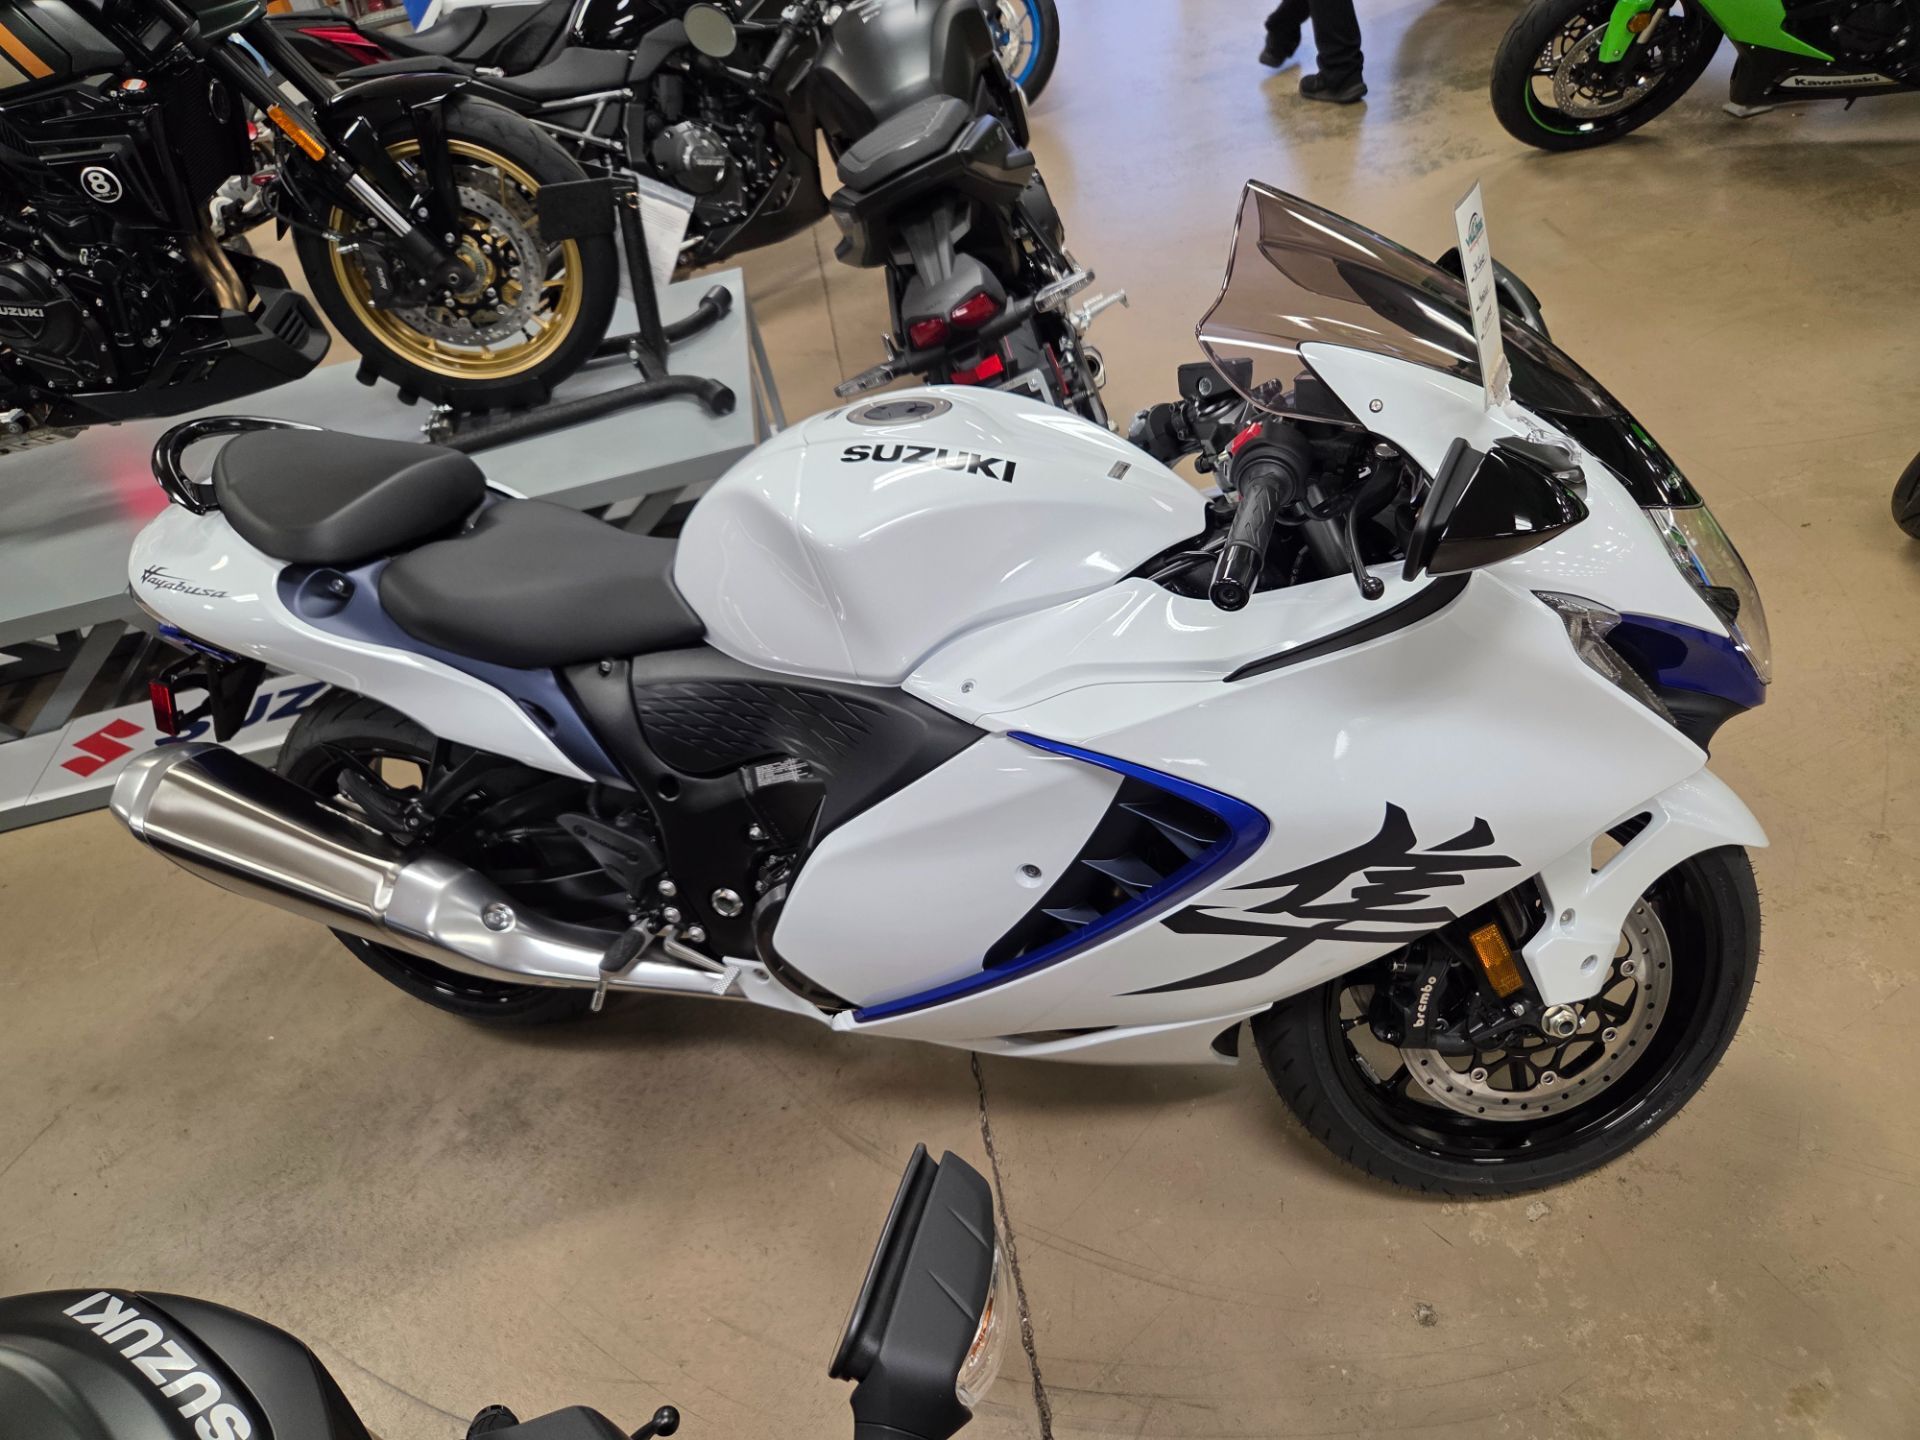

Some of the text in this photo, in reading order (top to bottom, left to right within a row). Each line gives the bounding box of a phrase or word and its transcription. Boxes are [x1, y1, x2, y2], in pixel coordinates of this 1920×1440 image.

[1794, 76, 1881, 86] Kawasaki
[87, 172, 111, 194] 8
[840, 444, 1017, 484] SUZUKI
[141, 565, 231, 598] Hayabusa
[1111, 801, 1522, 997] 隼
[1413, 976, 1437, 1028] brembo
